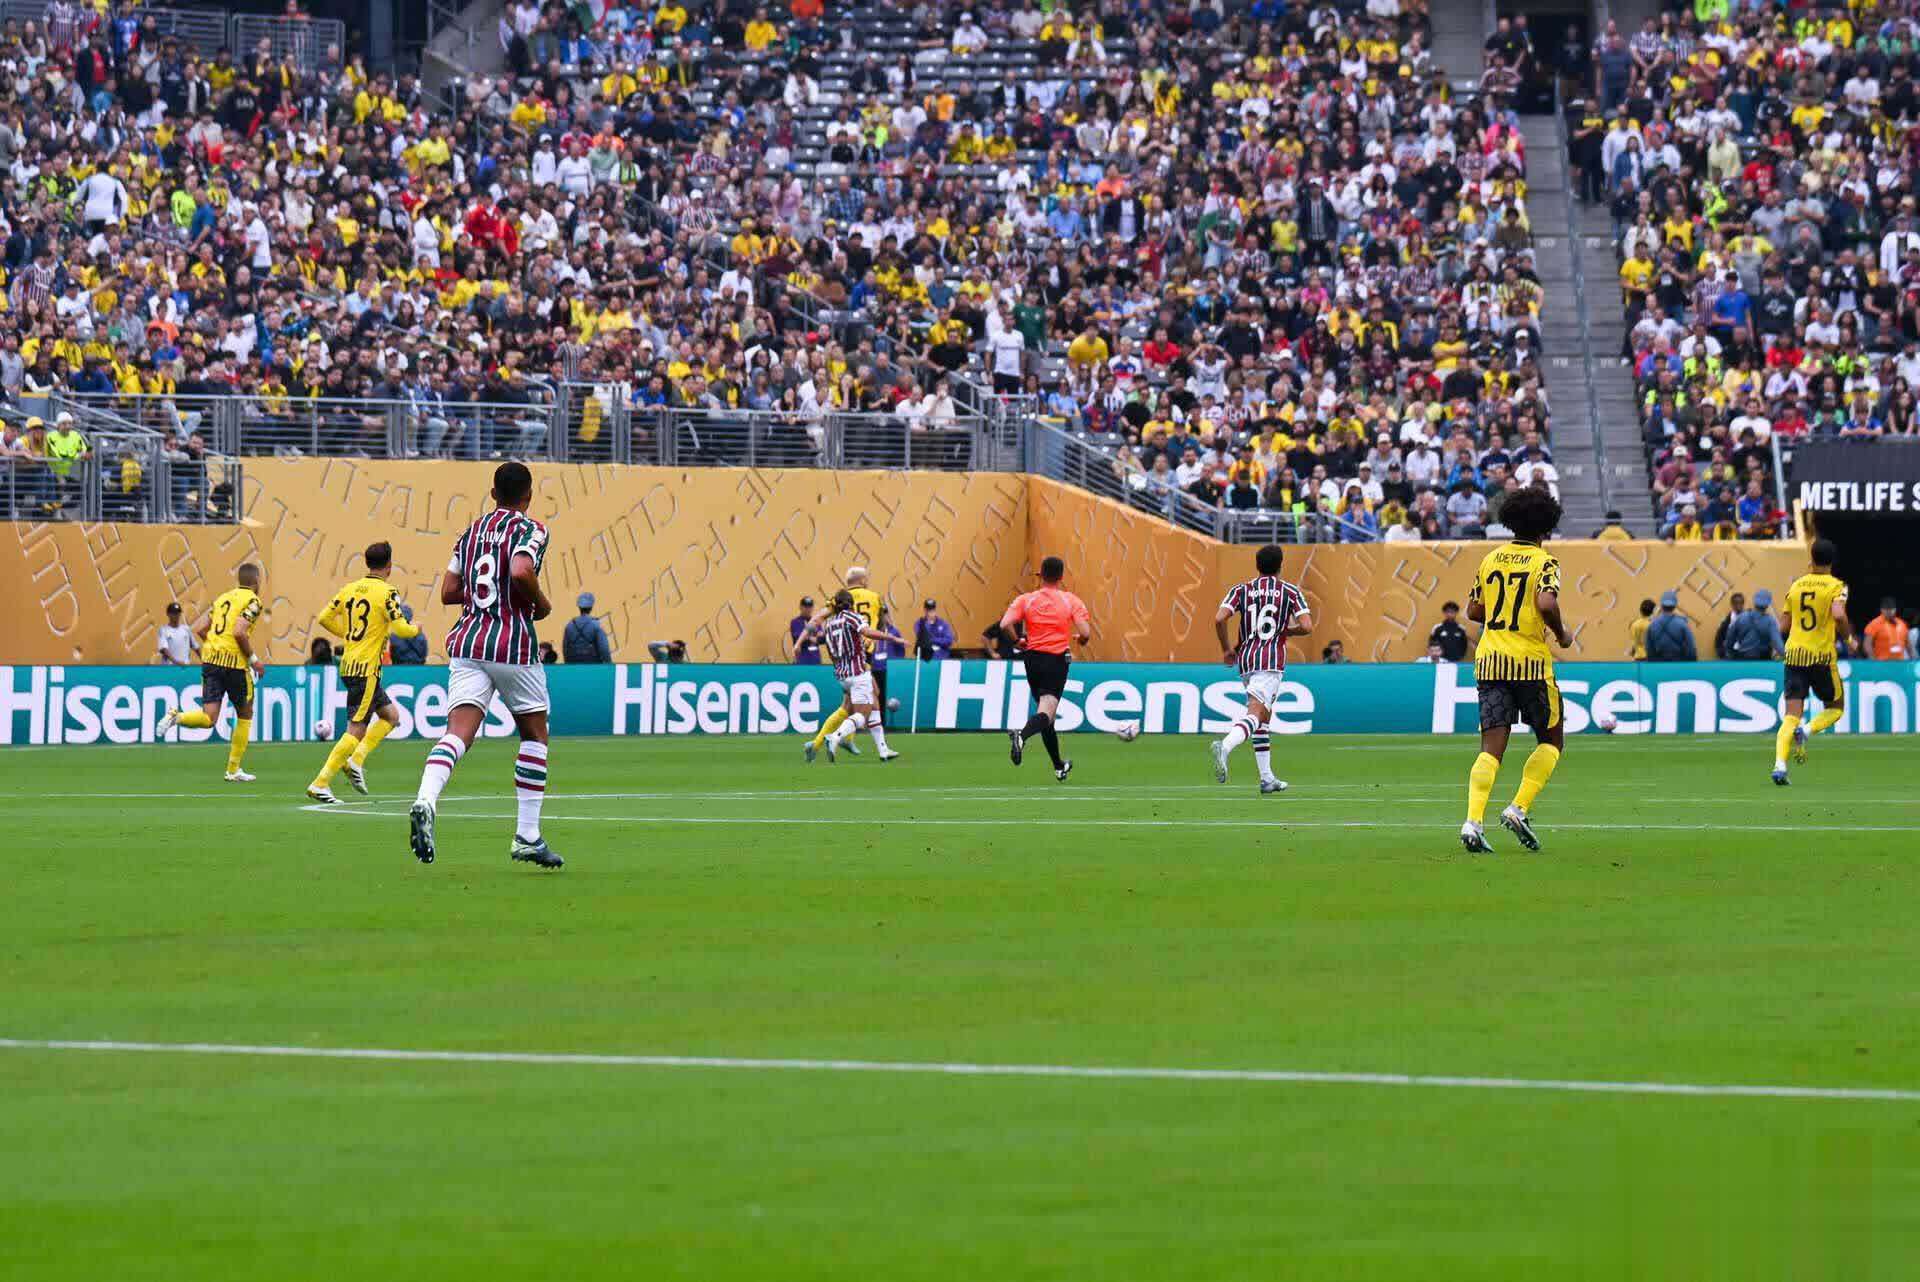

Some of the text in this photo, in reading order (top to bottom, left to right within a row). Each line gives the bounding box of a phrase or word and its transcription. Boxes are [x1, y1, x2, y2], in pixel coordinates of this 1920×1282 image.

[1800, 481, 1905, 511] METLIFE
[473, 553, 498, 609] 3
[1494, 552, 1532, 565] ADEYEMI
[215, 600, 231, 635] 3
[345, 597, 372, 642] 13
[1247, 603, 1278, 641] 16
[1486, 570, 1530, 632] 27
[1800, 591, 1817, 632] 5
[612, 663, 820, 735] Hisense
[935, 659, 1315, 734] Hisense
[1431, 662, 1828, 735] Hsens
